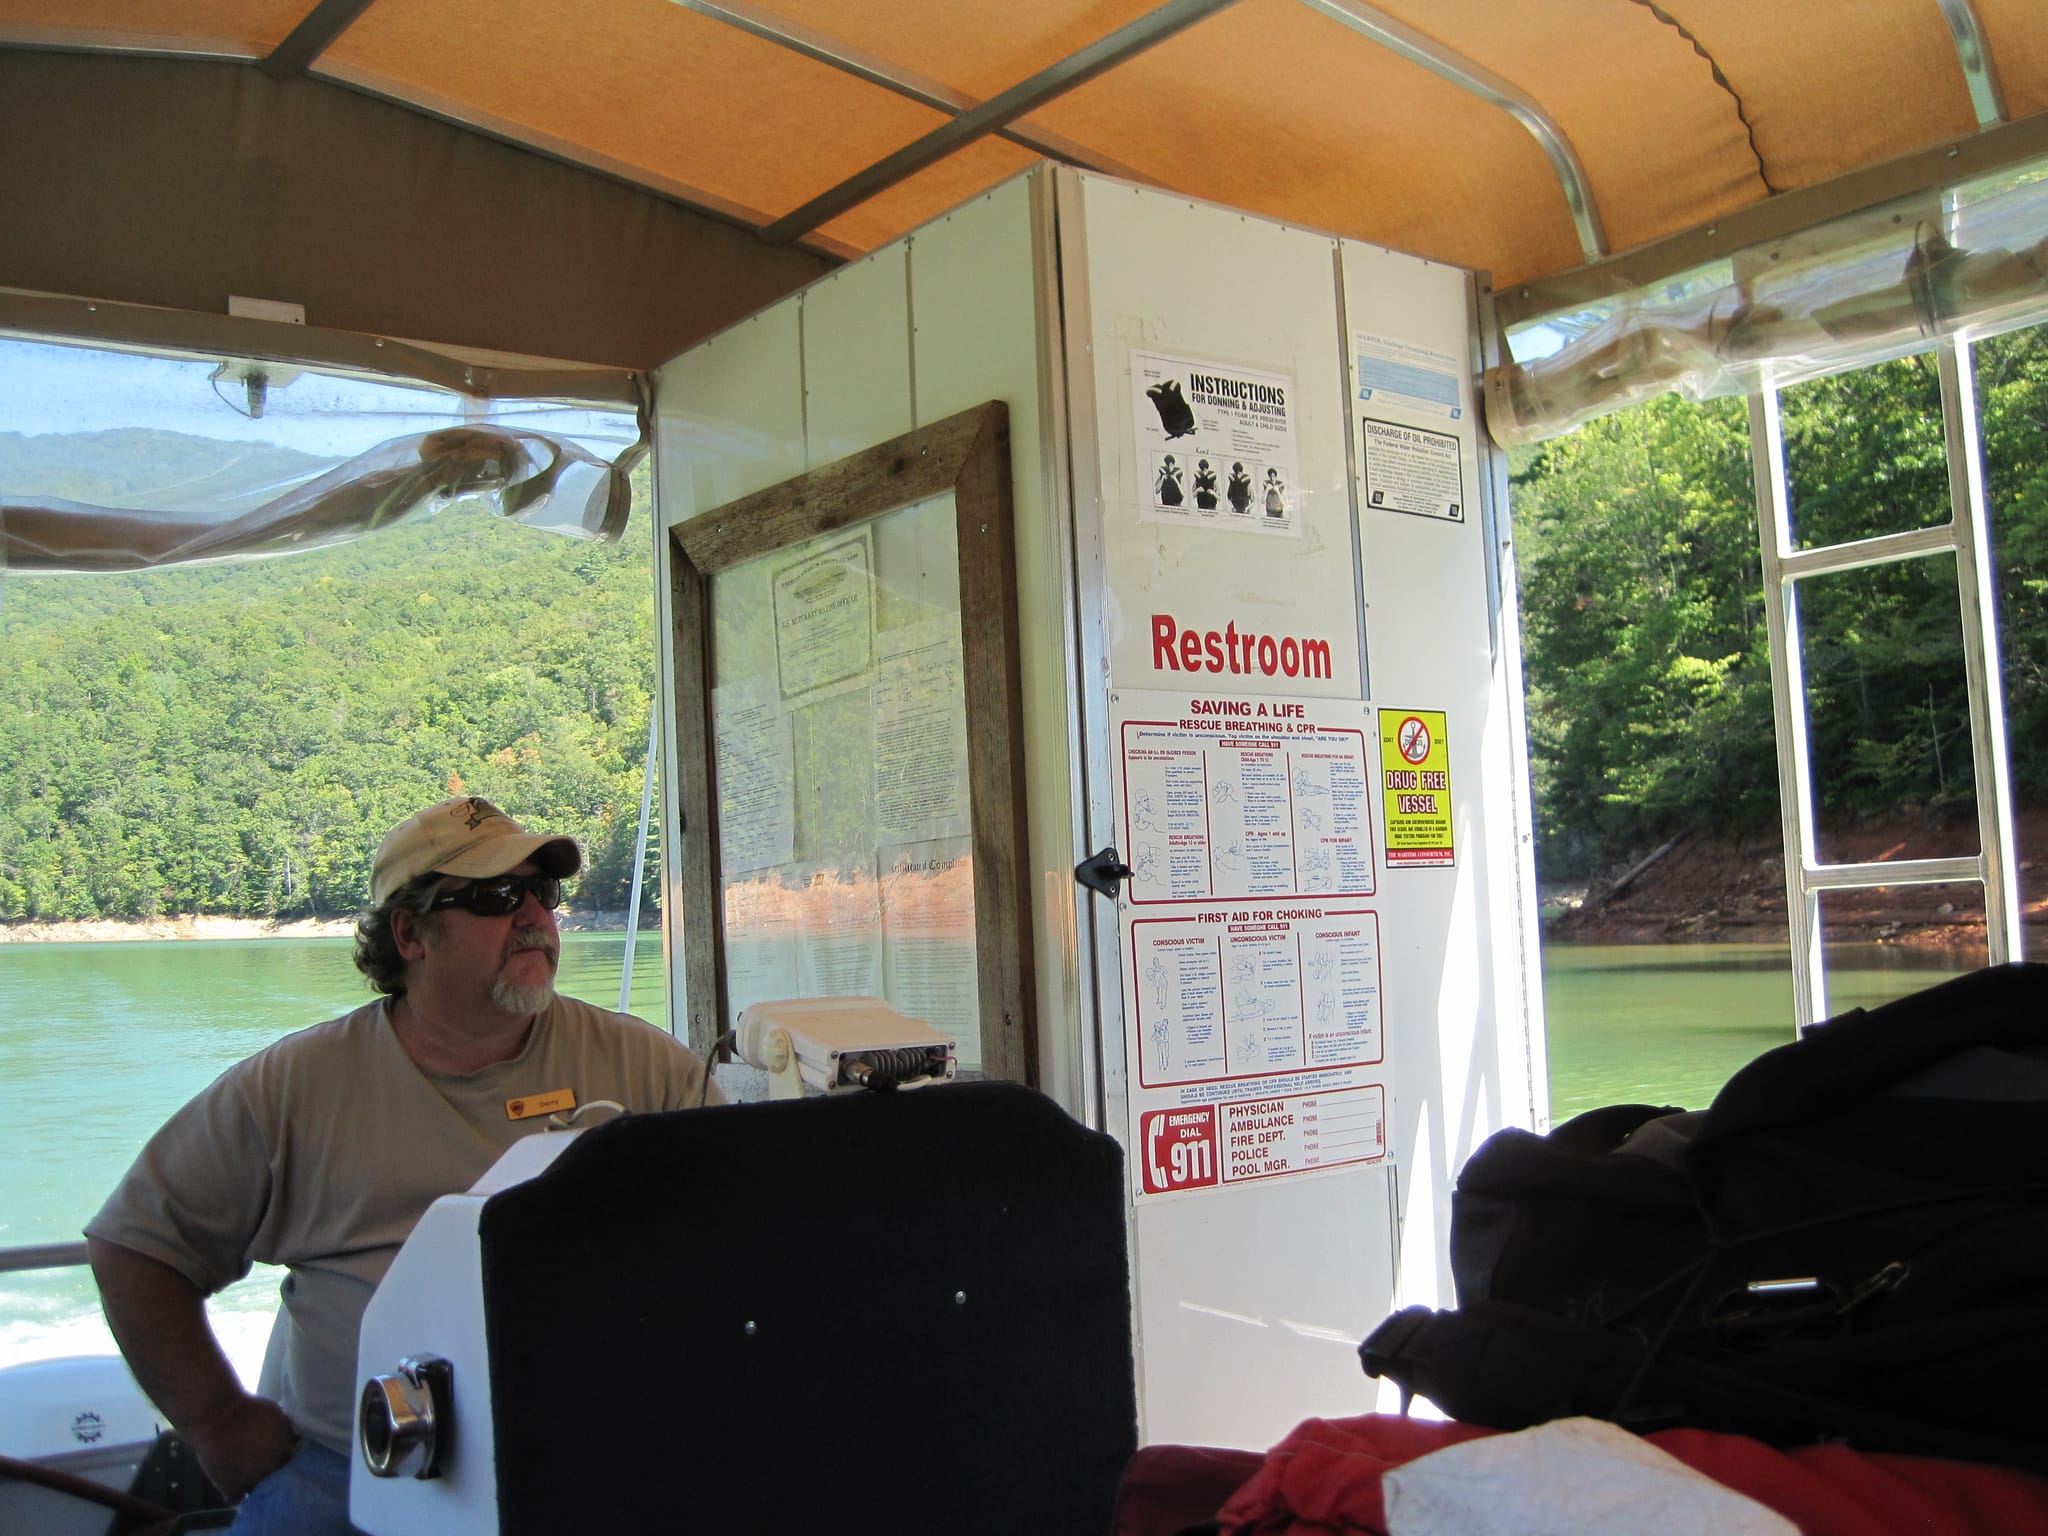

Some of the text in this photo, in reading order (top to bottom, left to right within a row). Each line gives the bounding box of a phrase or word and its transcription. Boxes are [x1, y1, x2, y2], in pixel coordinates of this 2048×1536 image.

[1190, 373, 1285, 406] INSTRUCTIONS
[1192, 393, 1286, 417] FOR DONNING & ADJUSTING
[1366, 424, 1457, 451] DISCHARGE OF OIL PROHIBITED
[1151, 613, 1332, 679] Restroom
[1190, 699, 1305, 719] SAVING A LIFE
[1179, 719, 1316, 734] RESCUE BREATHING & CPR
[1386, 769, 1447, 791] DRUG FREE
[1397, 794, 1438, 814] VESSEL
[1198, 909, 1322, 923] FIRST AID FOR CHOKING
[1152, 938, 1185, 946] CONSCIOUS
[1230, 935, 1267, 943] UNCONSCIOUS
[1315, 931, 1342, 939] CONSCIOUS
[1229, 1101, 1284, 1118] PHYSICIAN
[1302, 1100, 1317, 1108] PHONE
[1168, 1111, 1210, 1127] EMERGENCY
[1230, 1114, 1294, 1133] AMBULANCE
[1303, 1114, 1318, 1122] PHONE
[1180, 1128, 1202, 1139] DIAL
[1231, 1130, 1286, 1147] FIRE DEPT.
[1303, 1128, 1318, 1136] PHONE
[1231, 1147, 1269, 1162] POLICE
[1304, 1142, 1319, 1151] PHONE
[1171, 1139, 1211, 1183] 911
[1232, 1158, 1290, 1176] POOL MGR.
[1305, 1156, 1319, 1165] PHONE
